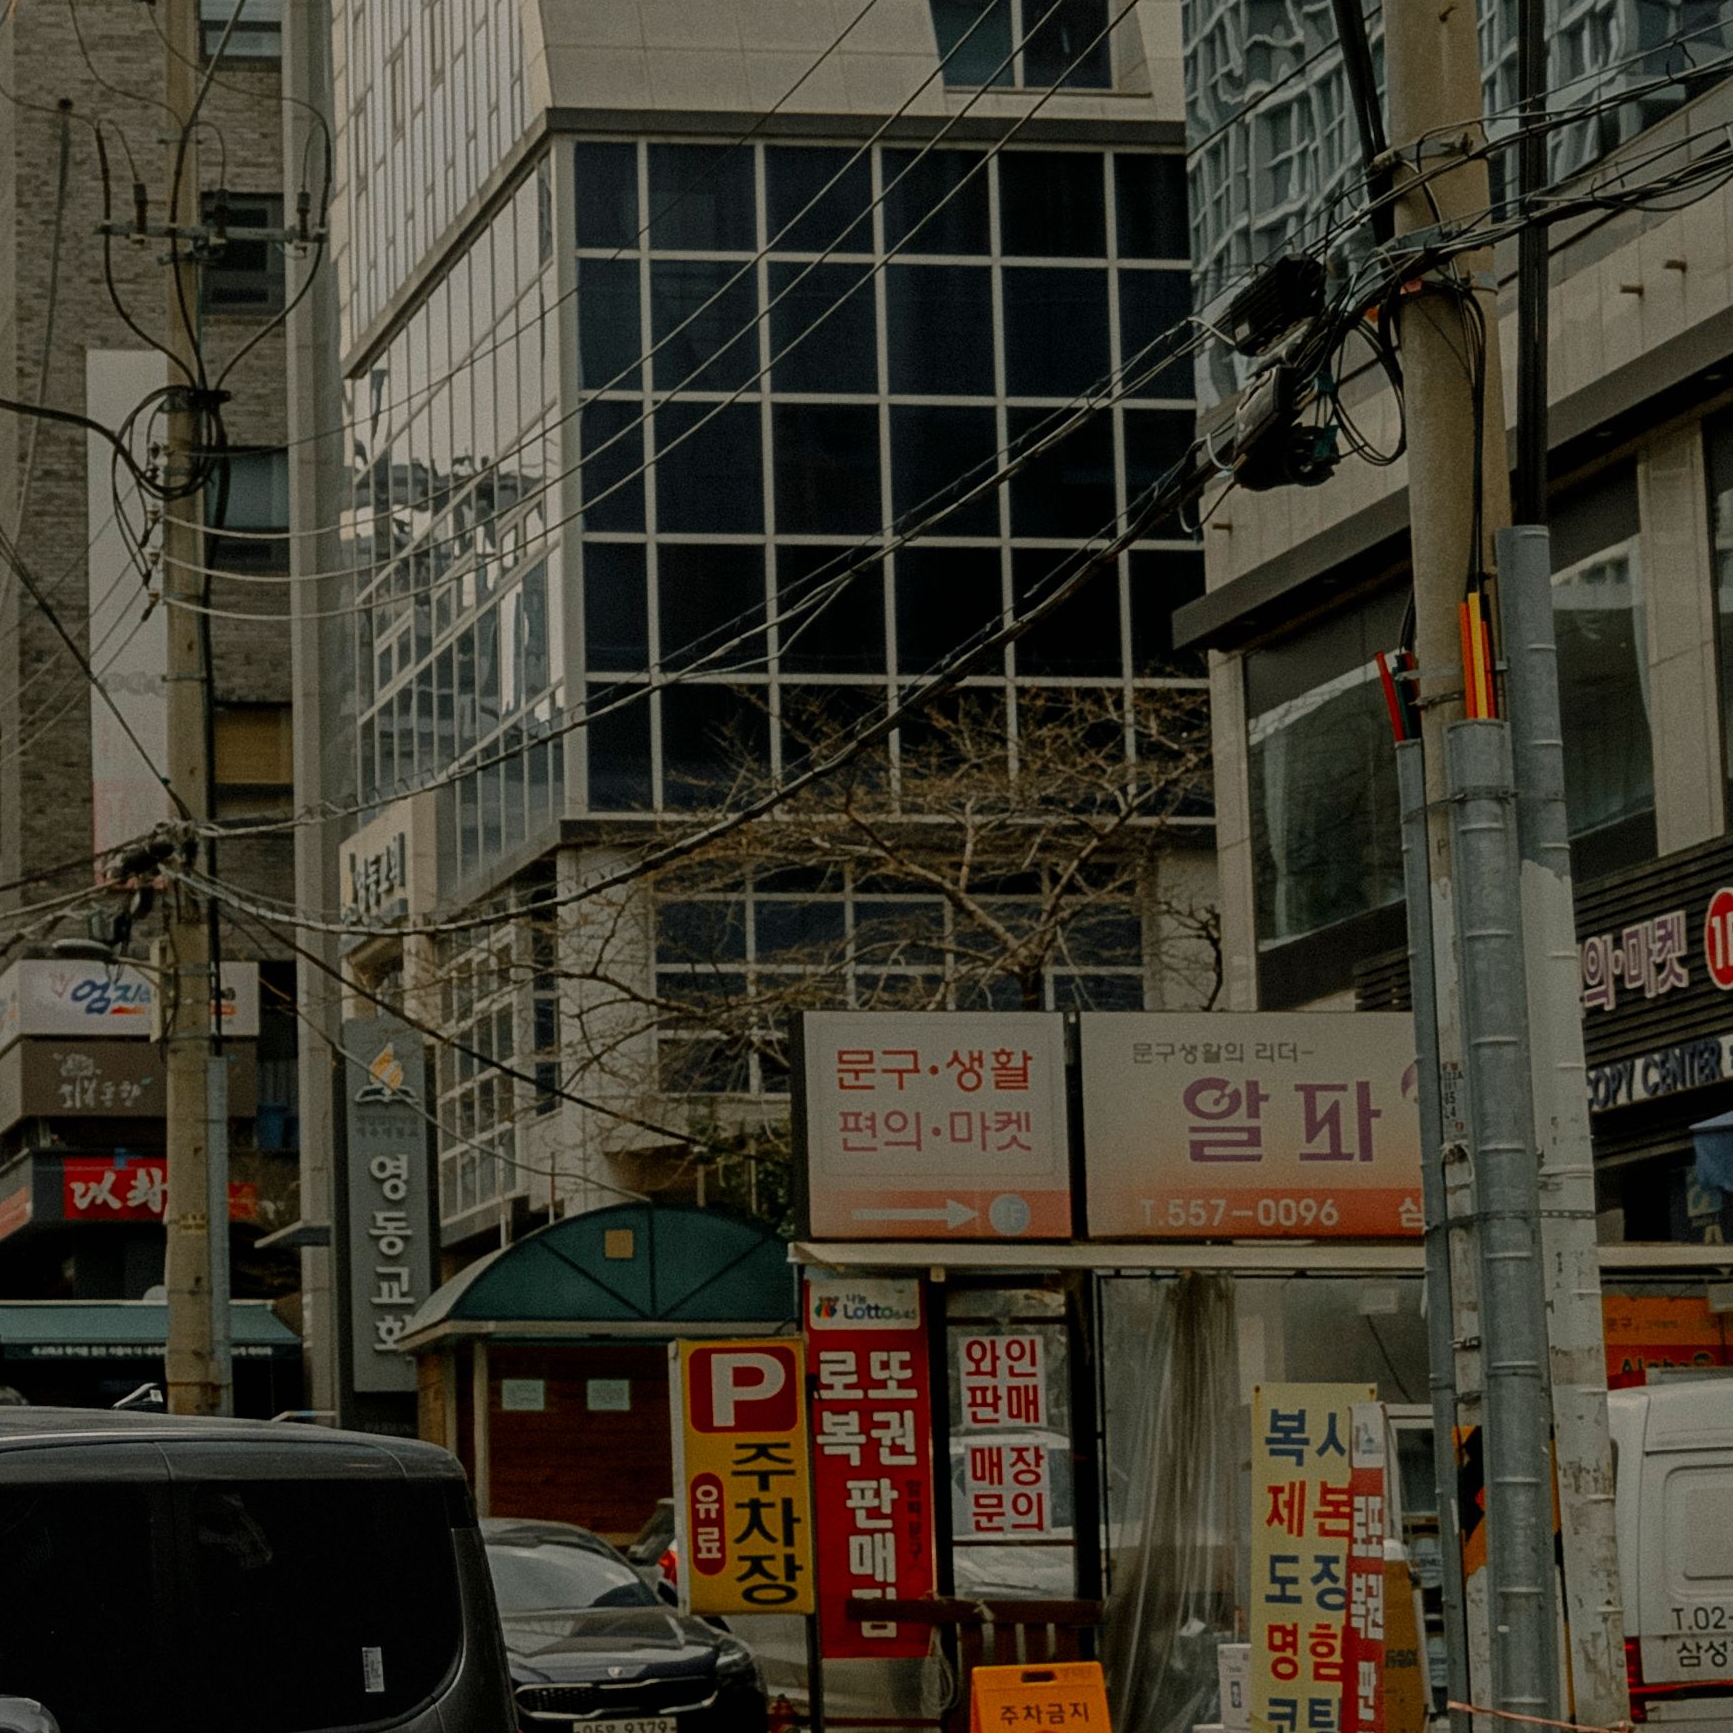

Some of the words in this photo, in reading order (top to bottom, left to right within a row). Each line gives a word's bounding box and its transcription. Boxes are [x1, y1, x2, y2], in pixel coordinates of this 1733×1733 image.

[1579, 910, 1689, 1010] 의·마켓
[1132, 1042, 1245, 1065] 문구생활의
[1641, 1036, 1722, 1097] CENTER
[1183, 1076, 1383, 1163] 알파
[369, 1151, 414, 1355] 영동교회
[965, 1338, 1037, 1378] 와인
[710, 1352, 786, 1428] P
[967, 1384, 1040, 1424] 판매
[816, 1409, 918, 1468] 복권
[970, 1445, 1044, 1486] 매장
[694, 1484, 723, 1561] 유료
[731, 1441, 804, 1606] 주차장
[972, 1492, 1044, 1532] 문의
[1676, 1639, 1733, 1668] 삼성
[999, 1701, 1090, 1726] 주차금지
